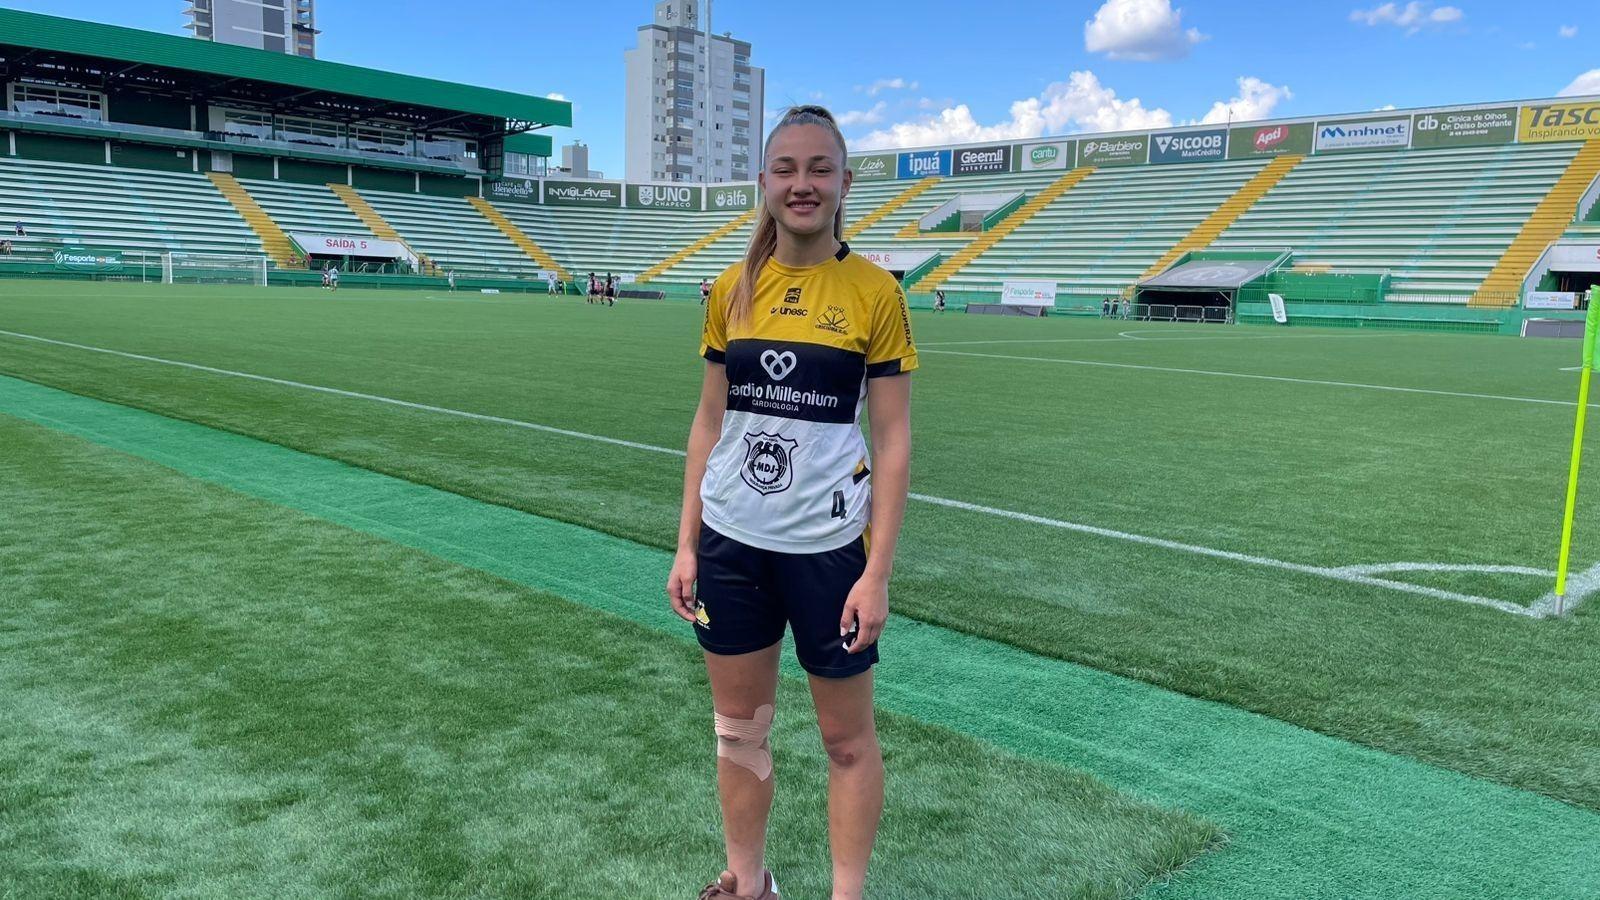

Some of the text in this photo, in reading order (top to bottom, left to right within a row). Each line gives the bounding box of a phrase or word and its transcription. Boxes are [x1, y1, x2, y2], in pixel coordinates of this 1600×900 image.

[1484, 112, 1508, 120] Olhos
[1417, 115, 1439, 131] db
[1477, 119, 1512, 128] bonfante
[1348, 123, 1405, 137] mhnet
[1528, 127, 1585, 140] Inspirando
[1171, 135, 1222, 150] SICOOB
[960, 149, 1004, 164] Geemil
[1032, 147, 1056, 158] cantu
[909, 151, 940, 175] ipuá
[548, 186, 617, 198] INVIOLÁVEL
[654, 186, 692, 202] UNO
[326, 238, 368, 249] SAÍDA 5
[63, 253, 96, 263] Fesporte
[884, 254, 890, 263] 6
[779, 306, 808, 317] unesc
[898, 296, 912, 347] COOPERJA
[729, 382, 838, 408] ardio Millenium
[751, 399, 799, 412] CARDIOLOGIA
[756, 462, 775, 474] MDJ
[831, 490, 847, 520] 4
